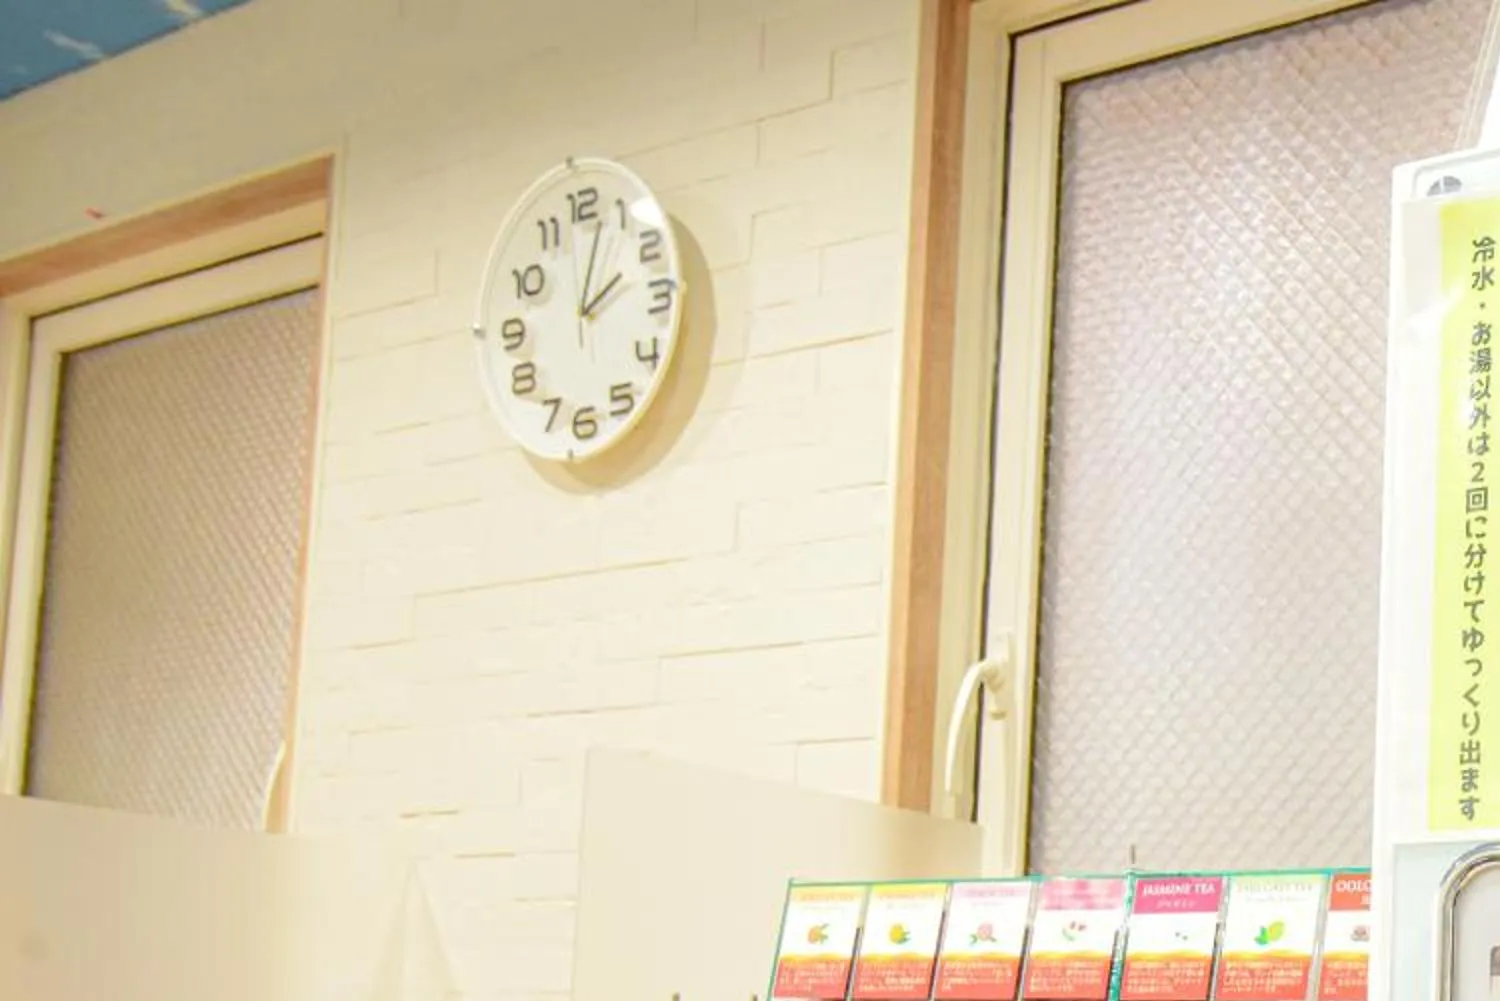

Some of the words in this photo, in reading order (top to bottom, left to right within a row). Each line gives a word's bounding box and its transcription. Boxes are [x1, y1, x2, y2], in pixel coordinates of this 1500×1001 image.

[567, 187, 599, 224] 12
[615, 198, 627, 230] 1
[537, 216, 560, 251] 11
[639, 230, 661, 263] 2
[511, 264, 545, 299] 10
[647, 278, 673, 314] 3
[502, 317, 526, 350] 9
[635, 337, 659, 369] 4
[511, 361, 536, 396] 8
[543, 398, 562, 432] 7
[609, 383, 635, 417] 5
[572, 407, 598, 440] 6
[1143, 884, 1190, 897] JASMINE
[1192, 883, 1216, 895] TEA
